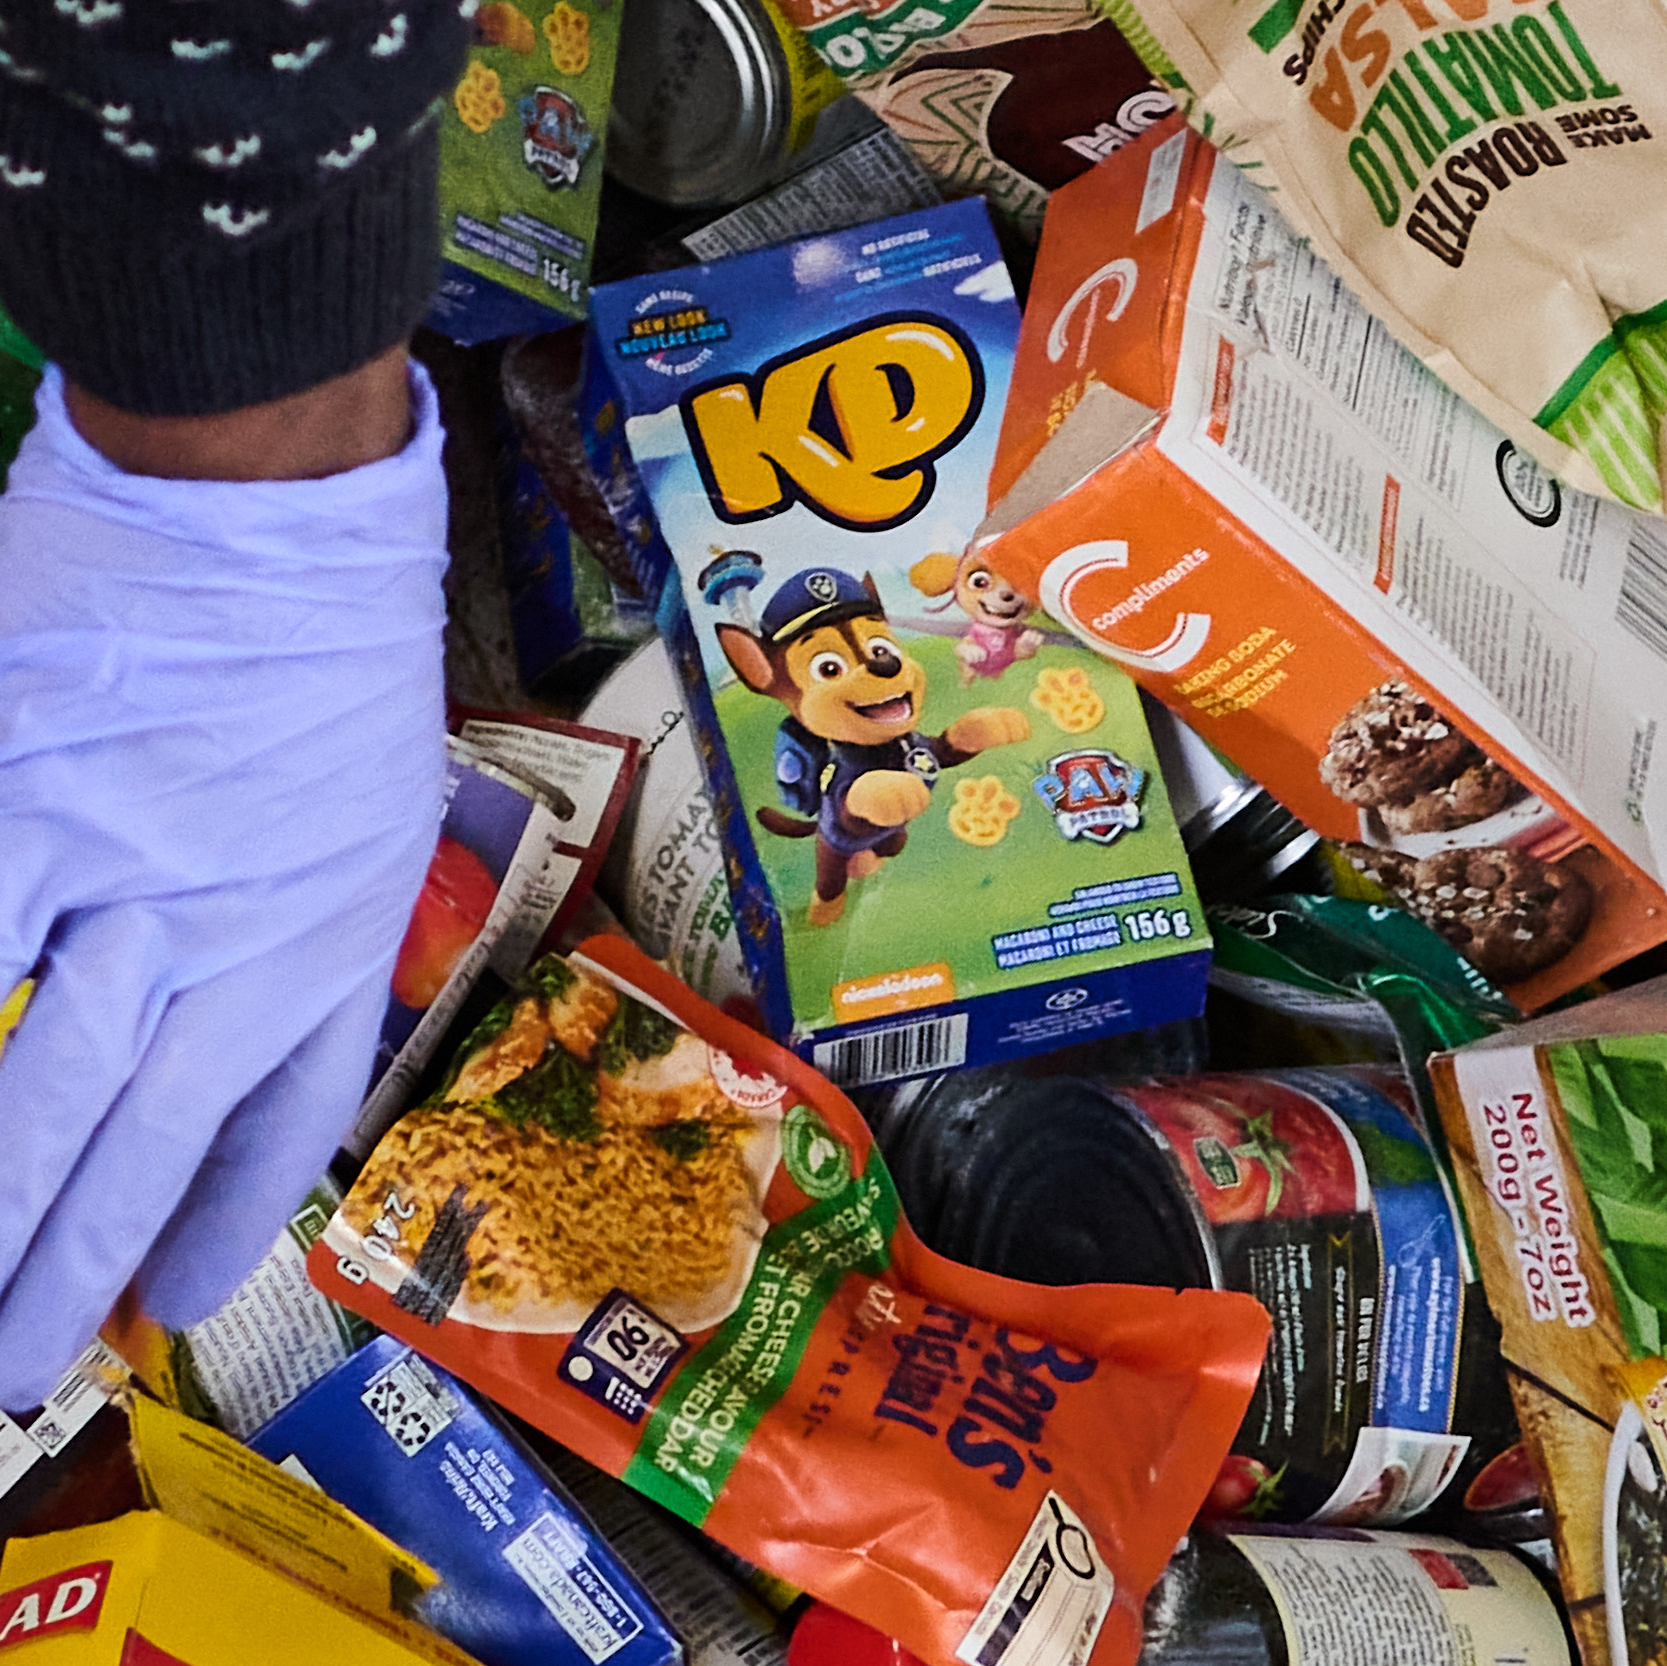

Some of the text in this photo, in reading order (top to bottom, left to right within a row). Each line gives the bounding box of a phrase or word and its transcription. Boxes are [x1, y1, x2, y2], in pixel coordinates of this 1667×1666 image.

[1346, 0, 1621, 228] TOMATILLO
[1553, 103, 1638, 133] SOME
[1566, 123, 1652, 151] MAKE
[1405, 120, 1567, 268] ROASTED
[541, 257, 574, 292] 156
[668, 309, 706, 328] LOOK
[1090, 546, 1209, 632] compliments
[1228, 623, 1276, 663] SODA
[993, 914, 1117, 950] MACARONI AND CHEESE
[1123, 908, 1192, 940] 156 g
[997, 943, 1056, 967] MACARONI
[1055, 940, 1070, 955] ET
[839, 969, 943, 1004] nickelodeon
[1482, 1101, 1554, 1314] 200g 7oz
[1511, 1090, 1589, 1321] Net Weight
[334, 1189, 416, 1285] 240 g
[948, 1326, 1099, 1490] Ben's
[521, 1536, 616, 1651] kraftcanada.com
